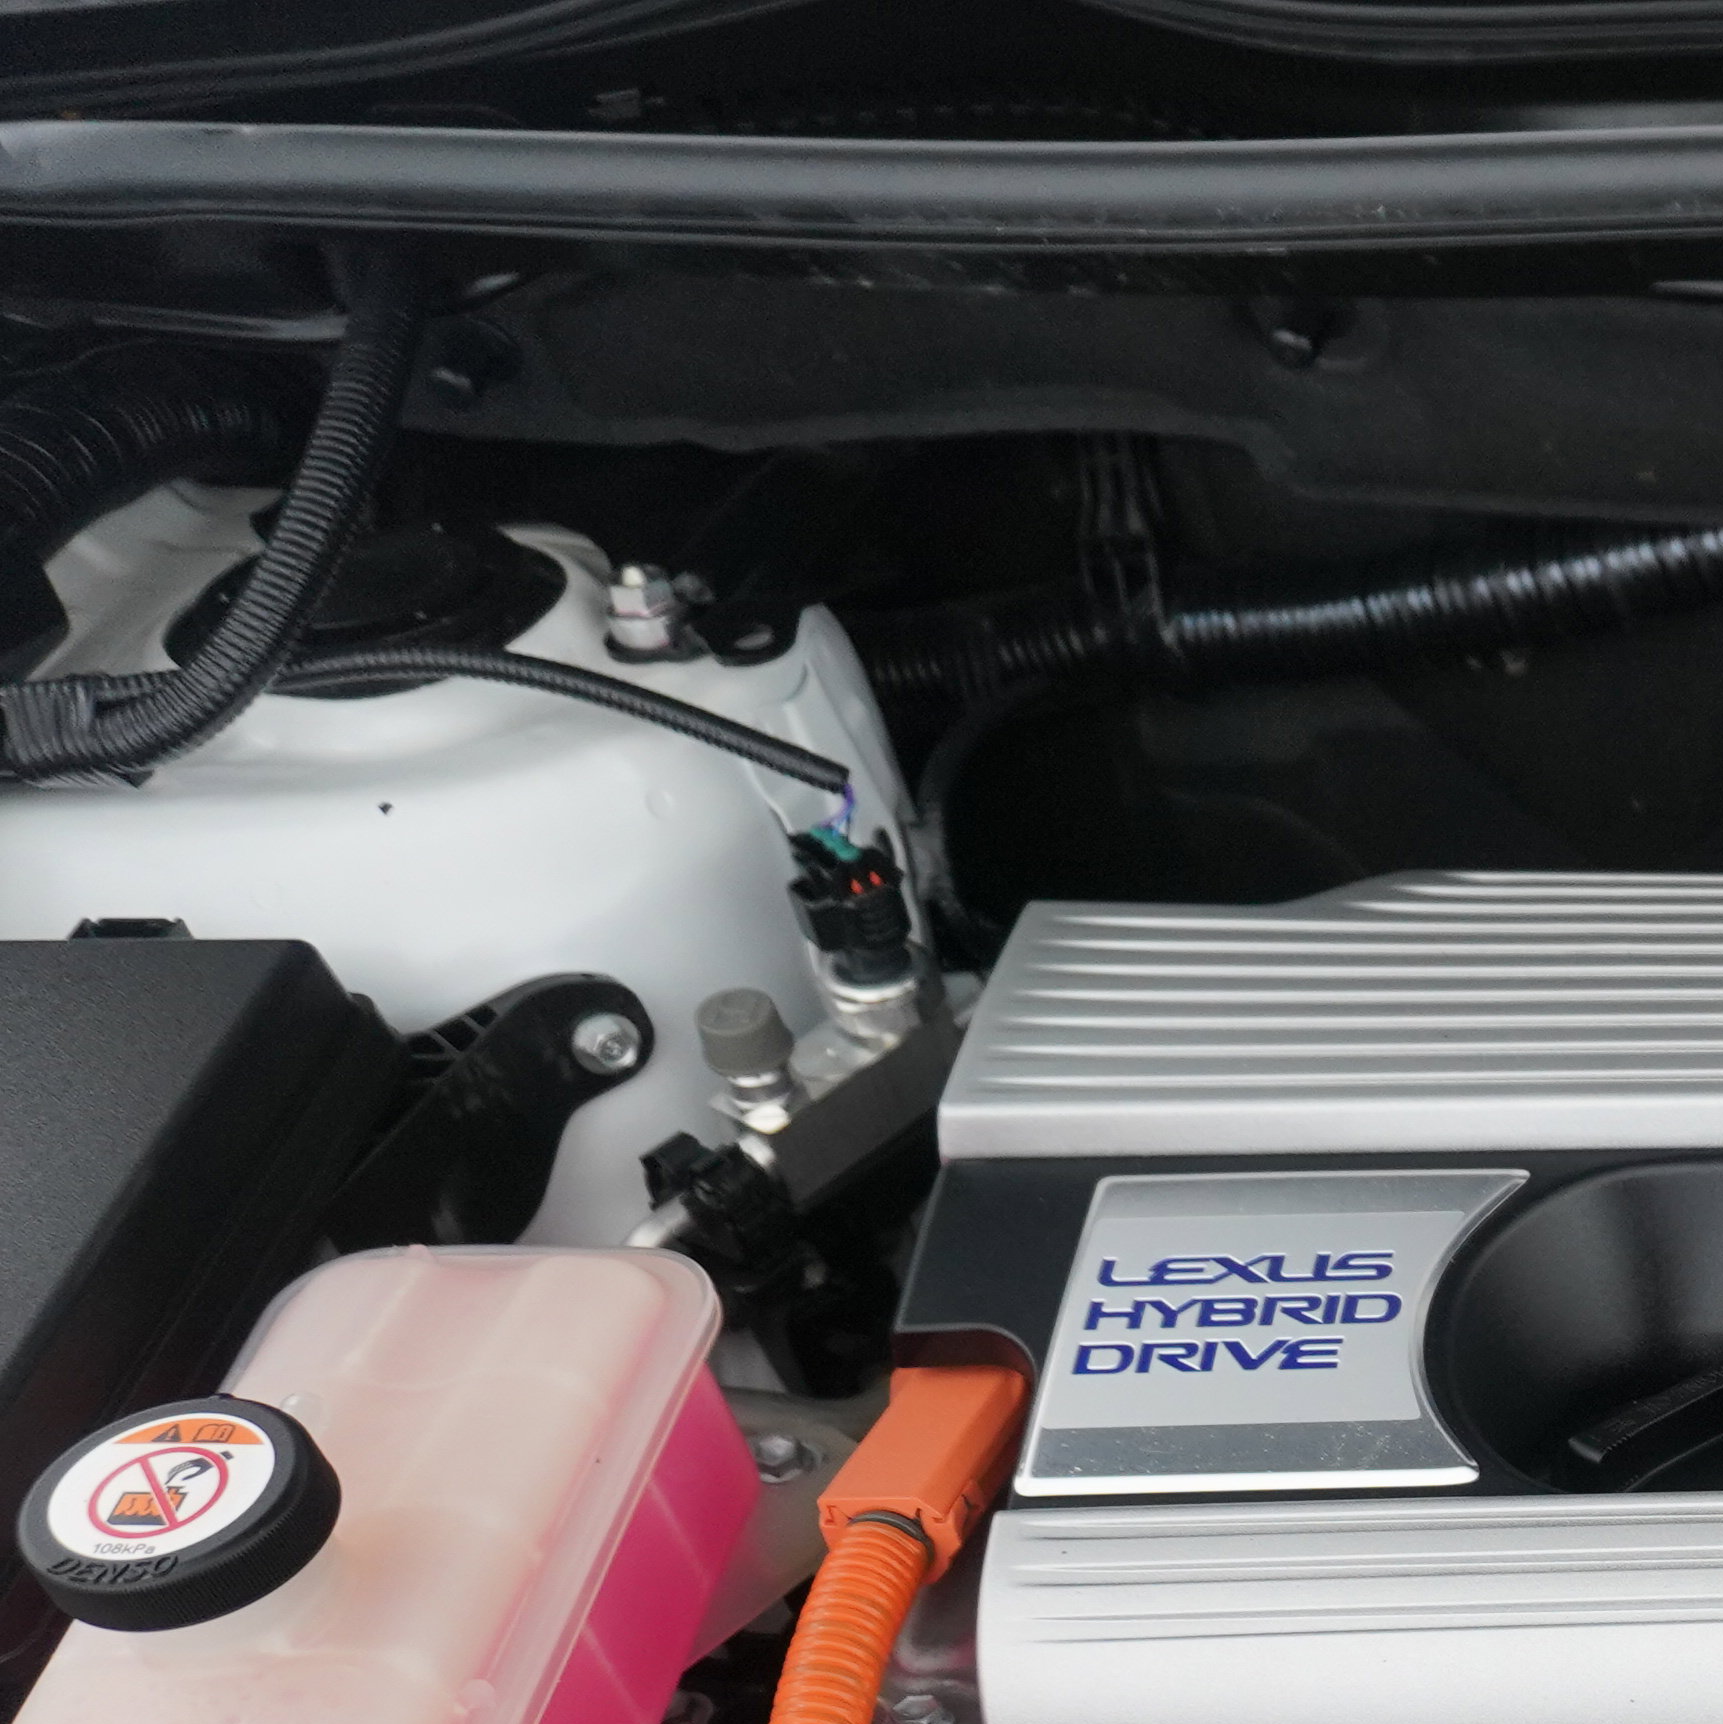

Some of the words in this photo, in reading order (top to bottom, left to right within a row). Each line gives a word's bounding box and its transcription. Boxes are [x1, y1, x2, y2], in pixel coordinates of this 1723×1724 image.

[1097, 1250, 1395, 1286] LEXUS
[1084, 1291, 1402, 1331] HYBRID
[1072, 1335, 1344, 1376] DRIVE
[93, 1542, 156, 1556] 108kPa
[47, 1554, 179, 1586] DENSO
